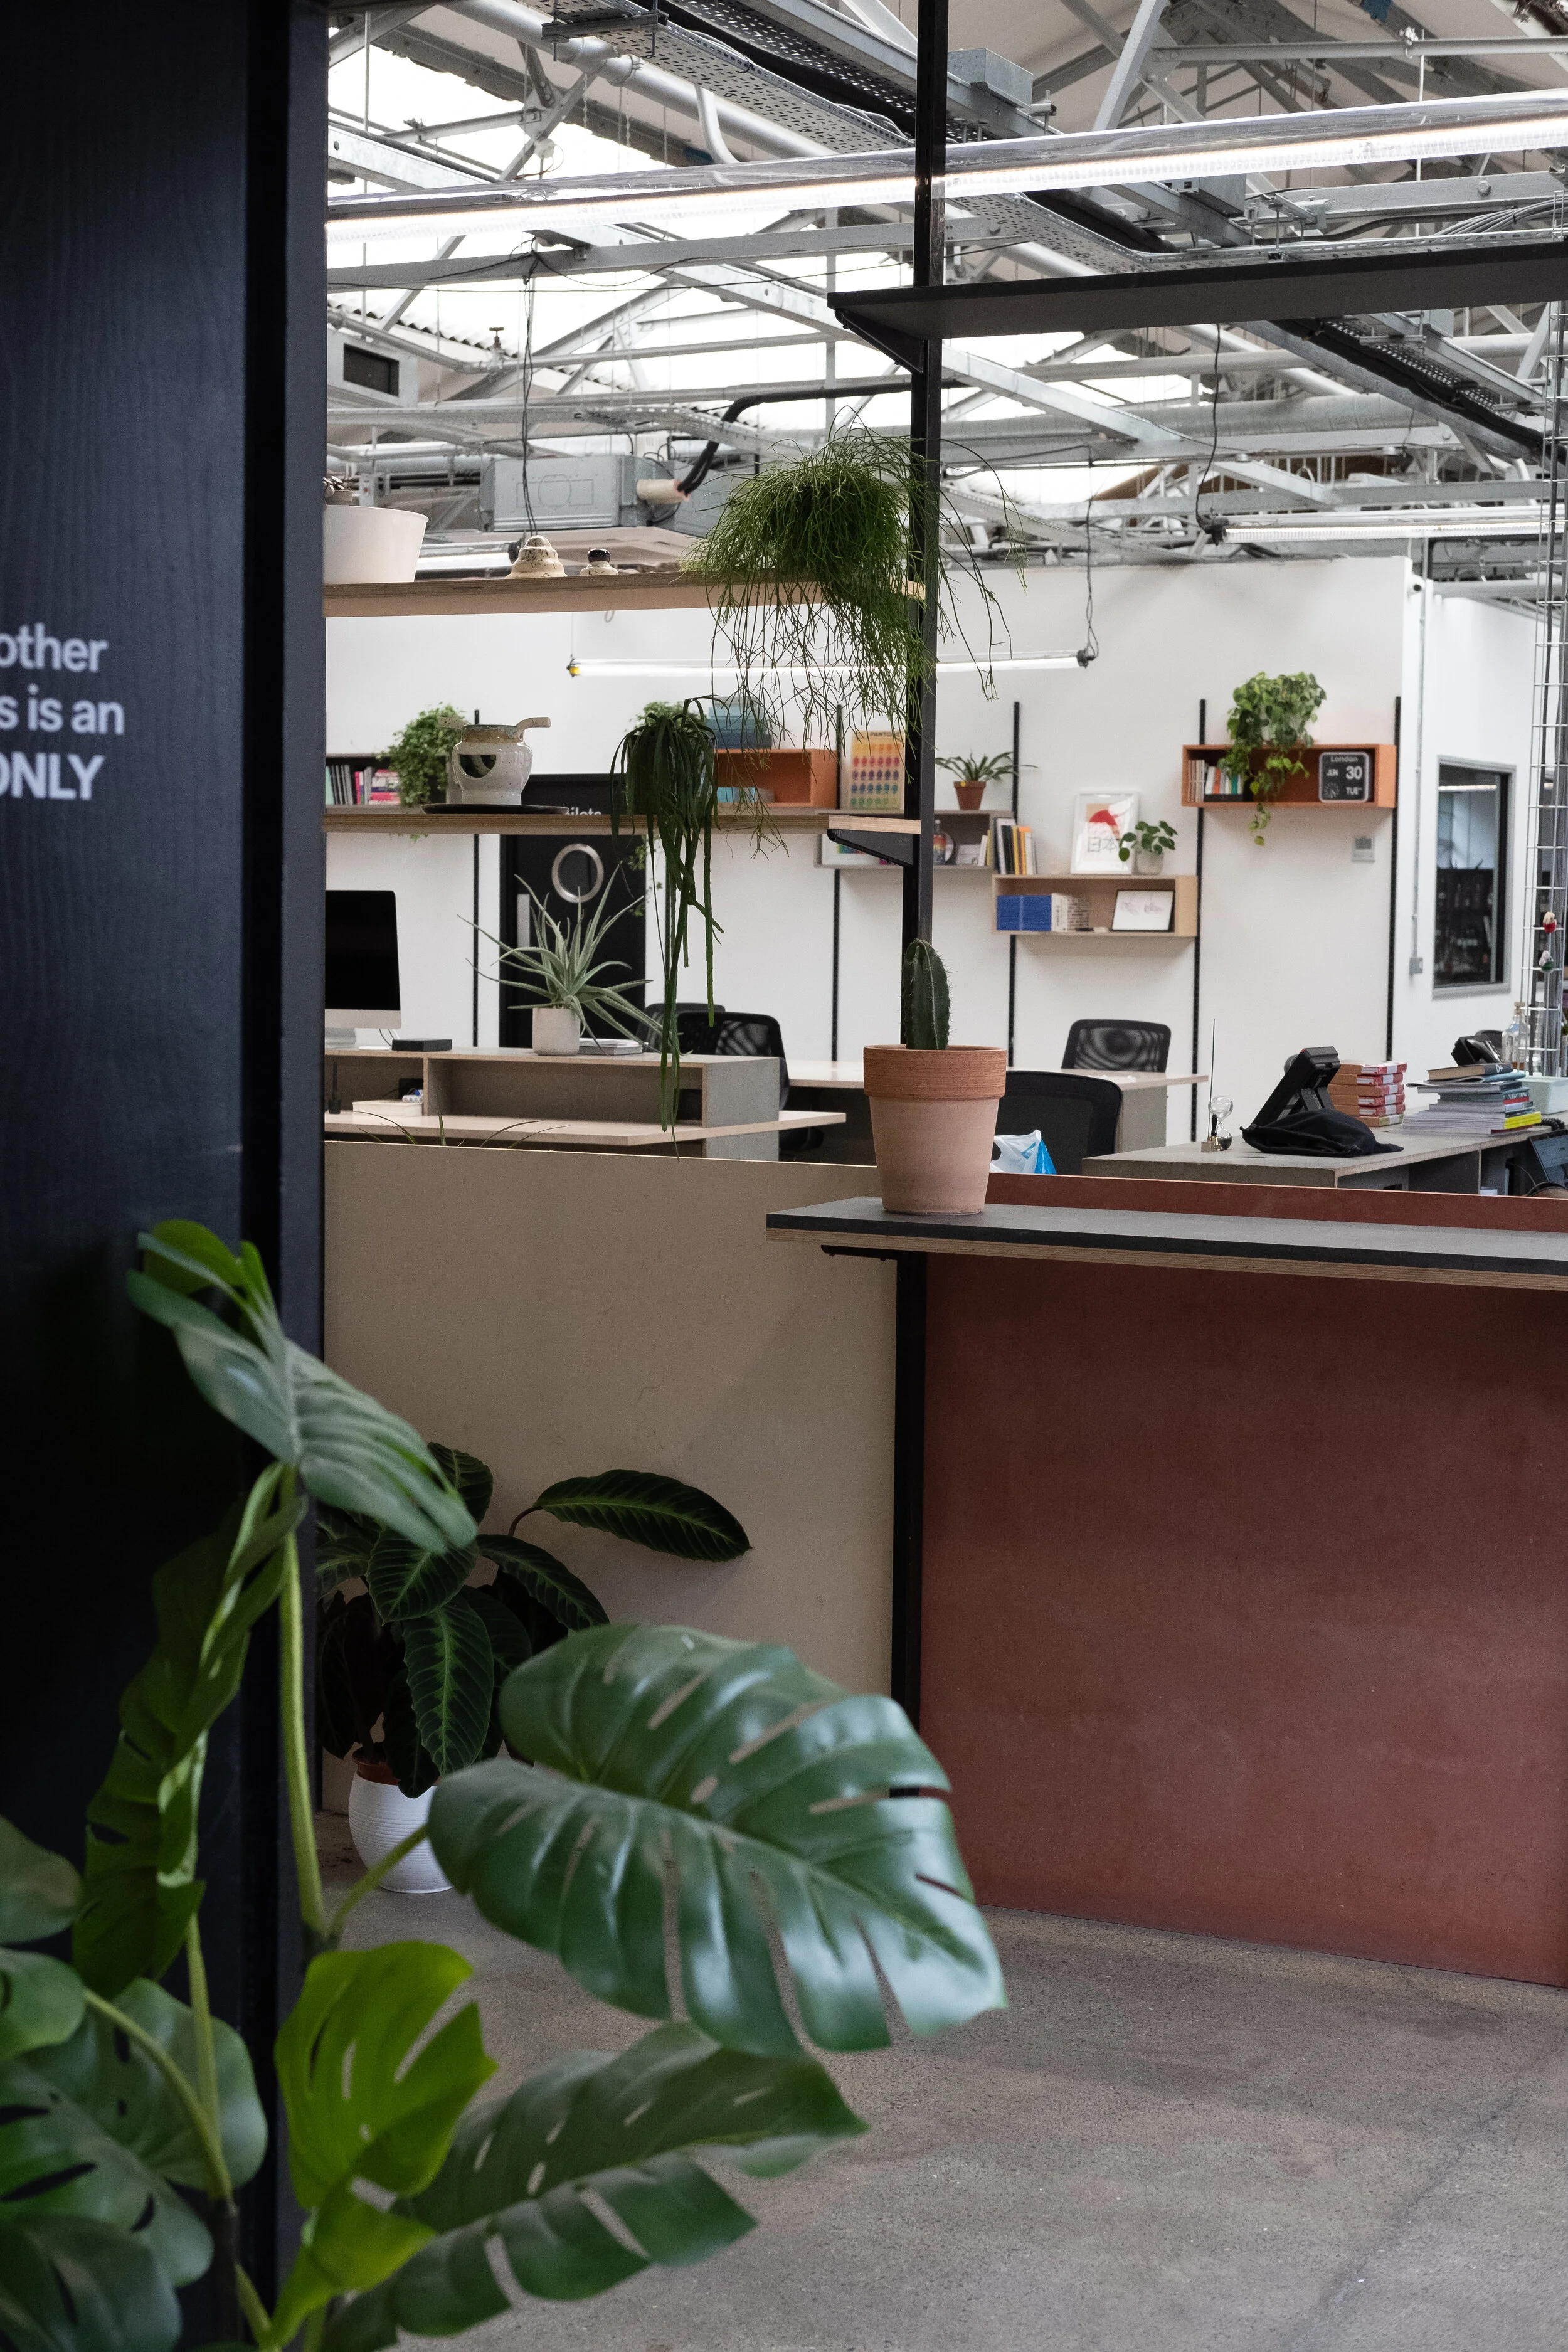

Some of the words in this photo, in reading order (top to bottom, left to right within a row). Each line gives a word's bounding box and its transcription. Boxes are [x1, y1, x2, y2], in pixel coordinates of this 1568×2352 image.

[28, 684, 63, 732] is
[71, 700, 125, 734] an
[0, 752, 105, 800] NLY
[1345, 765, 1363, 780] 30
